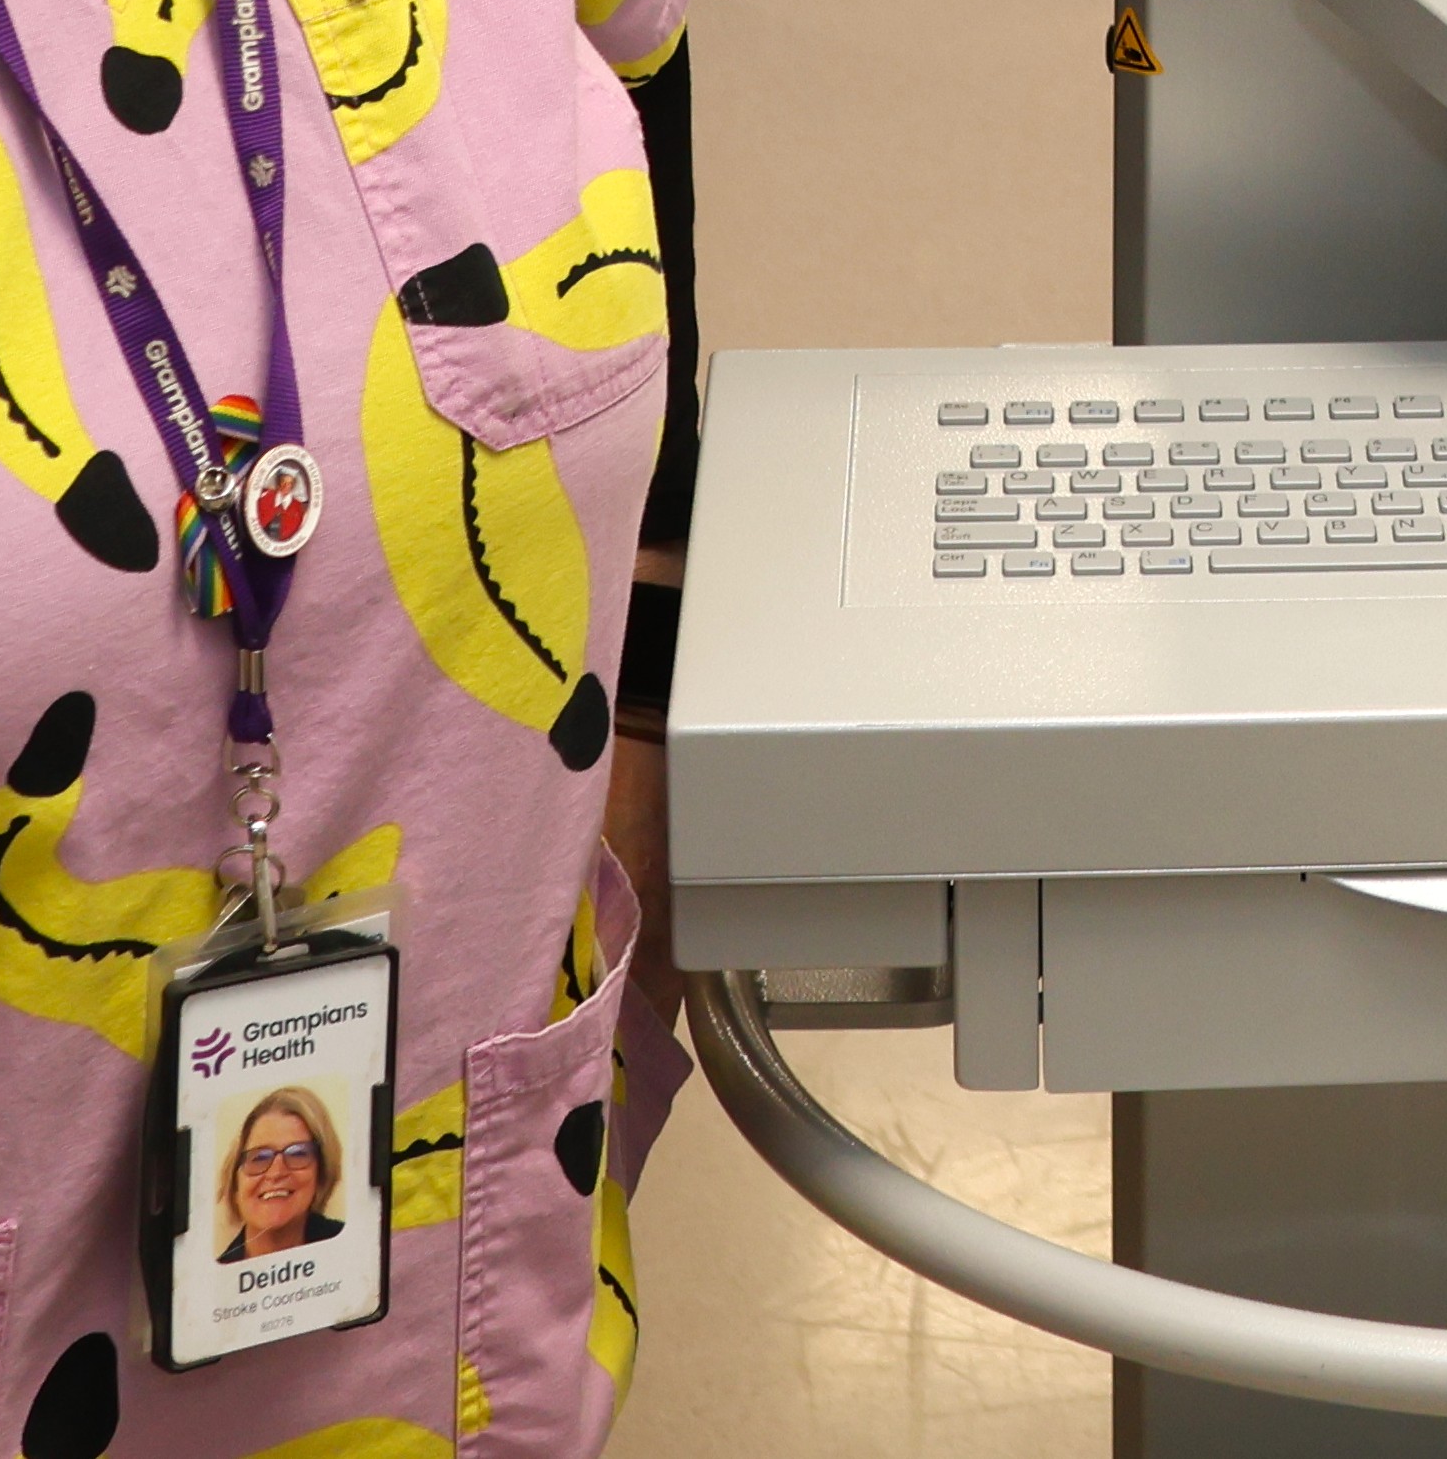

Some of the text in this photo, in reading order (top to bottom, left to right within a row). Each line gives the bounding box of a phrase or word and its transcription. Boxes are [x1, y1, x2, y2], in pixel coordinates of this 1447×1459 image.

[1010, 471, 1028, 480] Q
[1077, 470, 1099, 479] W
[1144, 470, 1157, 479] E
[1210, 469, 1224, 478] R
[1278, 467, 1291, 476] T
[1344, 467, 1357, 475] Y
[1408, 465, 1425, 474] U
[941, 505, 976, 513] Lock
[1029, 560, 1050, 568] Fn
[243, 999, 369, 1044] Grampians
[242, 1035, 315, 1069] Health
[238, 1260, 316, 1294] Deidre
[212, 1279, 343, 1324] Stroke Coordinator
